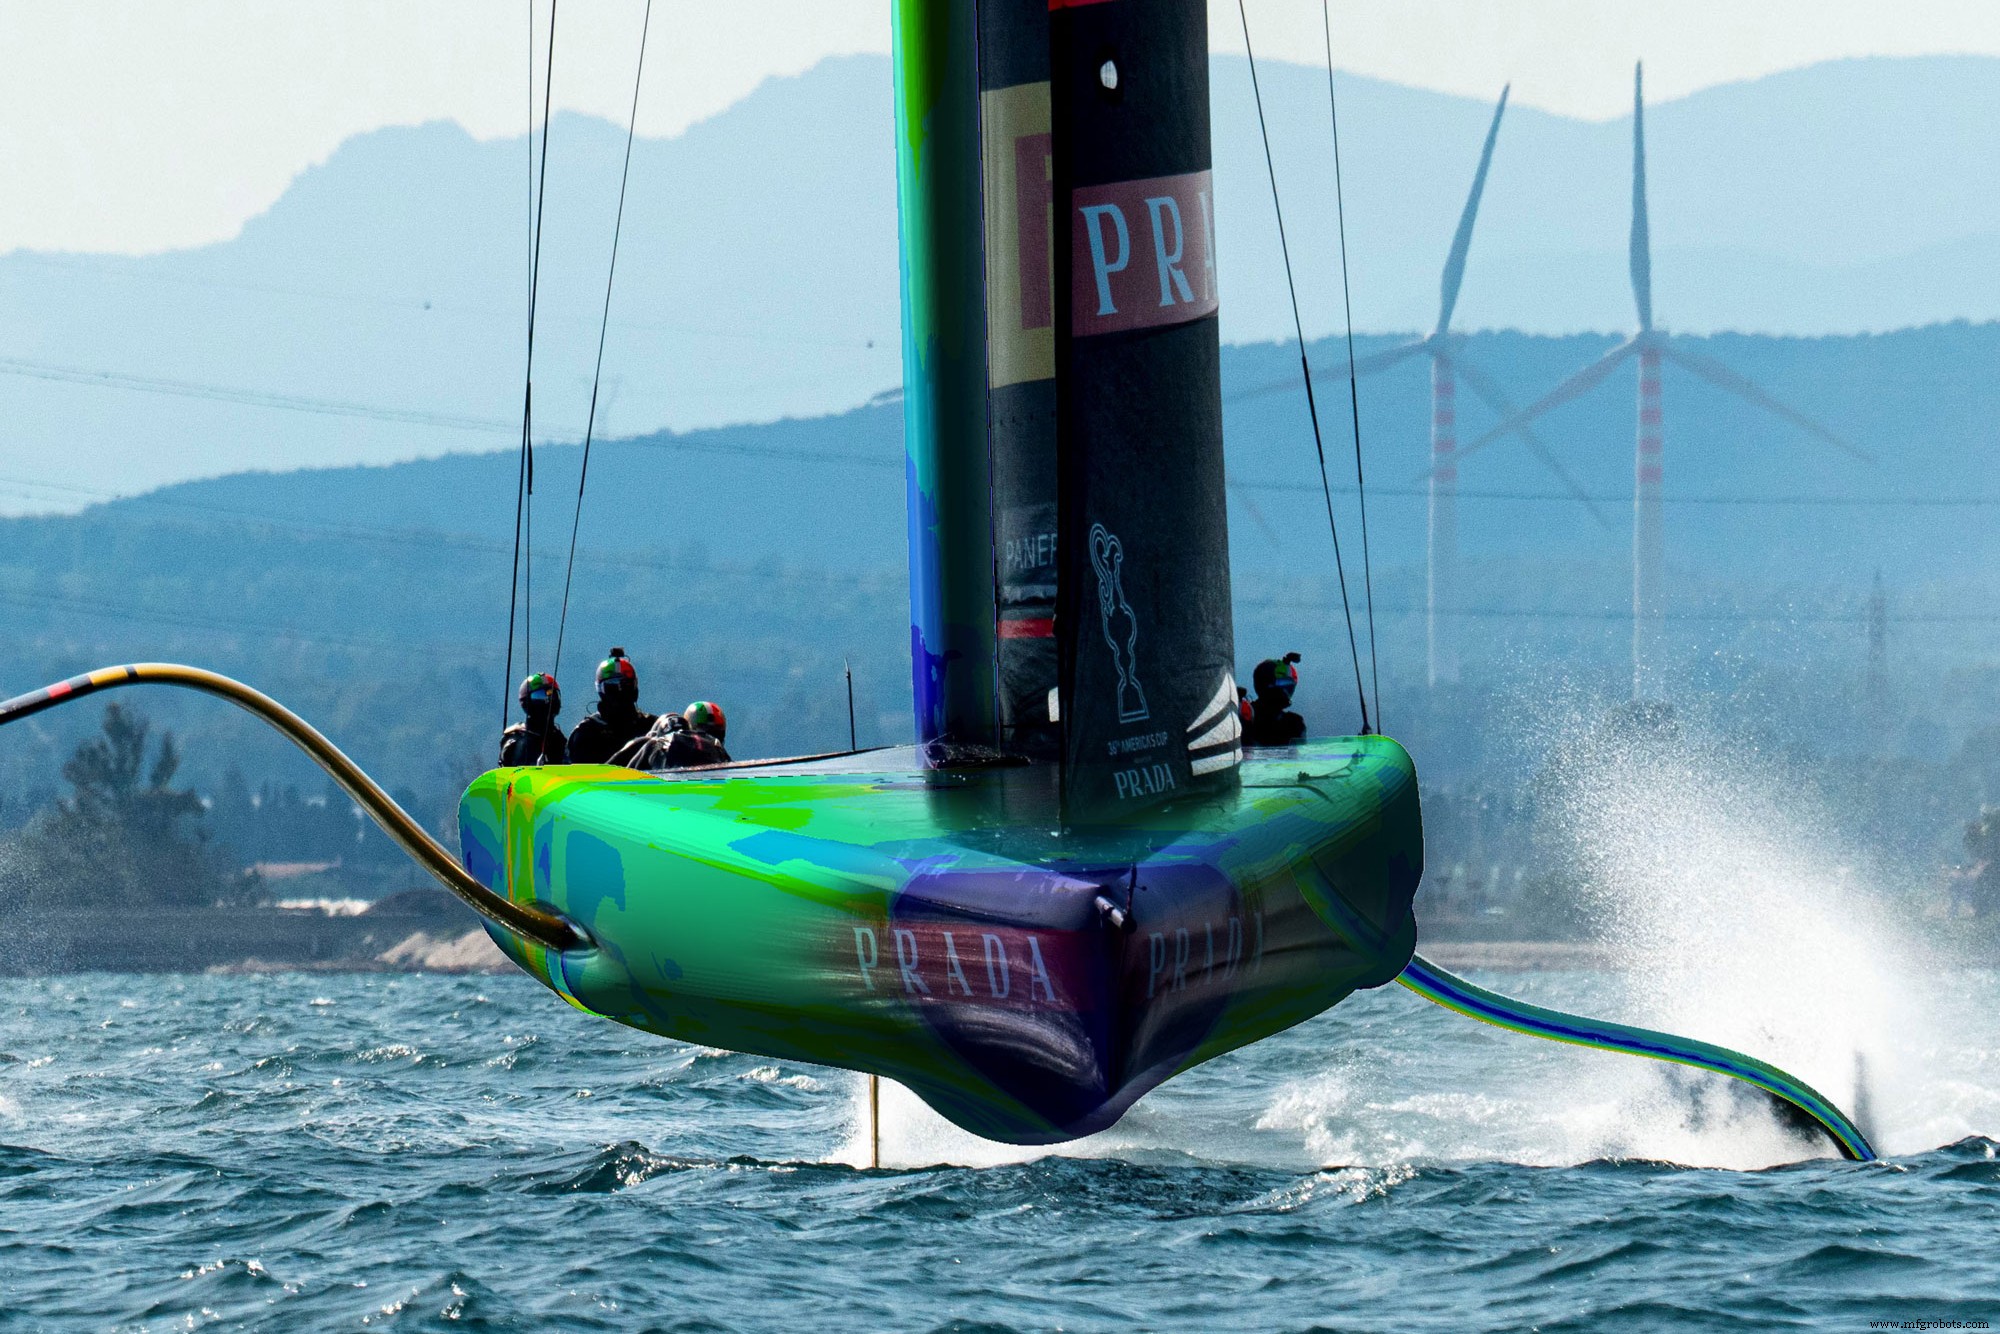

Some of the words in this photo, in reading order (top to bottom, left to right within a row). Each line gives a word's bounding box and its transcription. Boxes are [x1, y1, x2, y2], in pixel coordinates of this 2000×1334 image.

[1113, 763, 1176, 799] PRADA
[853, 927, 1057, 1001] PRADA
[1147, 911, 1263, 999] PRADA
